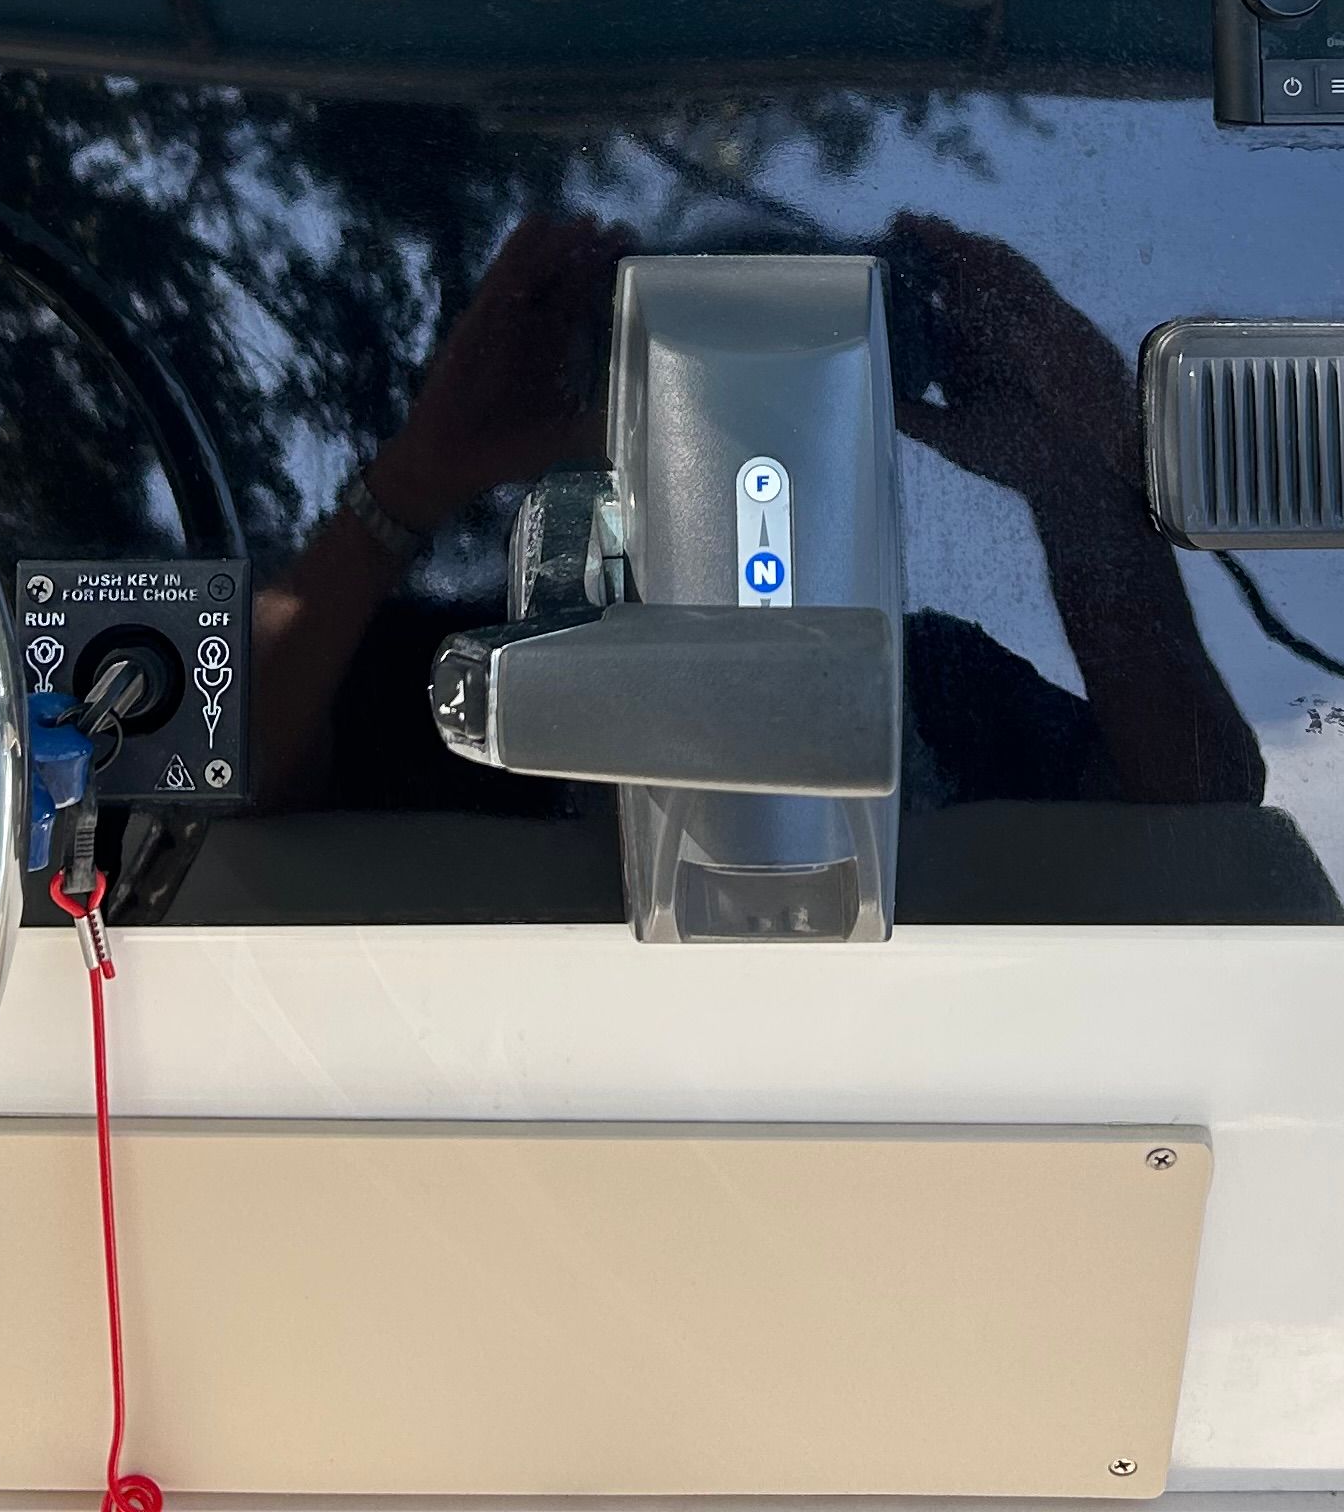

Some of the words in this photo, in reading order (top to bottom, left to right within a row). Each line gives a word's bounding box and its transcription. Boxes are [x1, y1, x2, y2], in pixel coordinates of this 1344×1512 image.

[756, 475, 769, 492] F
[753, 560, 778, 584] N
[77, 573, 122, 587] PUSH
[127, 573, 158, 587] KEY
[164, 573, 181, 586] IN
[62, 590, 94, 602] FOR
[99, 589, 137, 602] FULL
[143, 589, 199, 602] CHOKE
[24, 612, 66, 626] RUN
[198, 612, 232, 626] OFF
